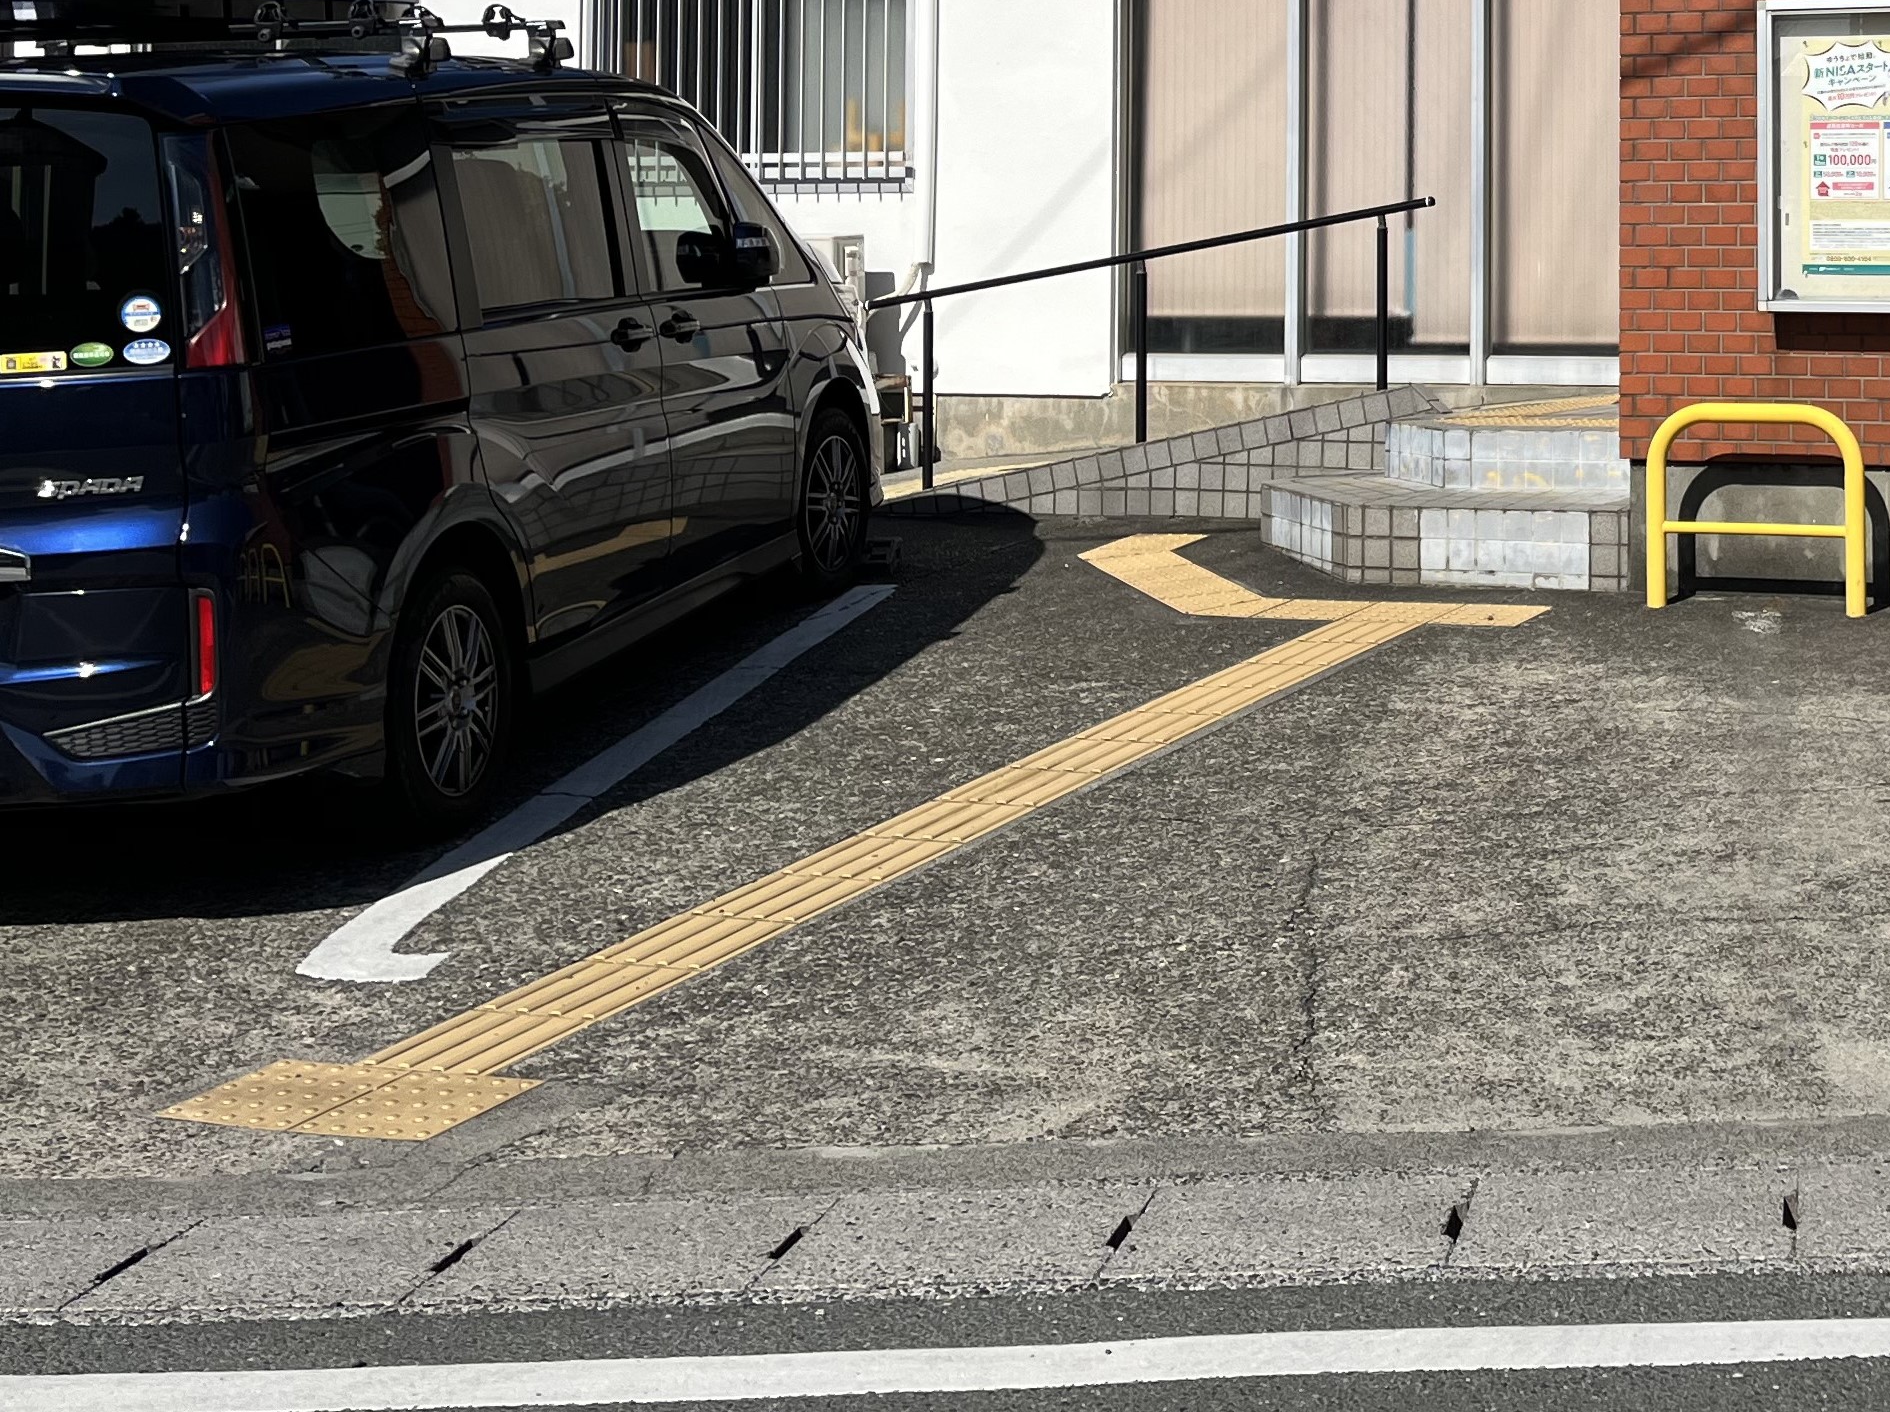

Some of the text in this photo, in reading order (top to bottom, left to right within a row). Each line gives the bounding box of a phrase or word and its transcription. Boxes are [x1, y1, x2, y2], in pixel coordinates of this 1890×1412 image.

[1814, 61, 1888, 79] 新NISAスタート
[1828, 75, 1877, 87] キャンペーン
